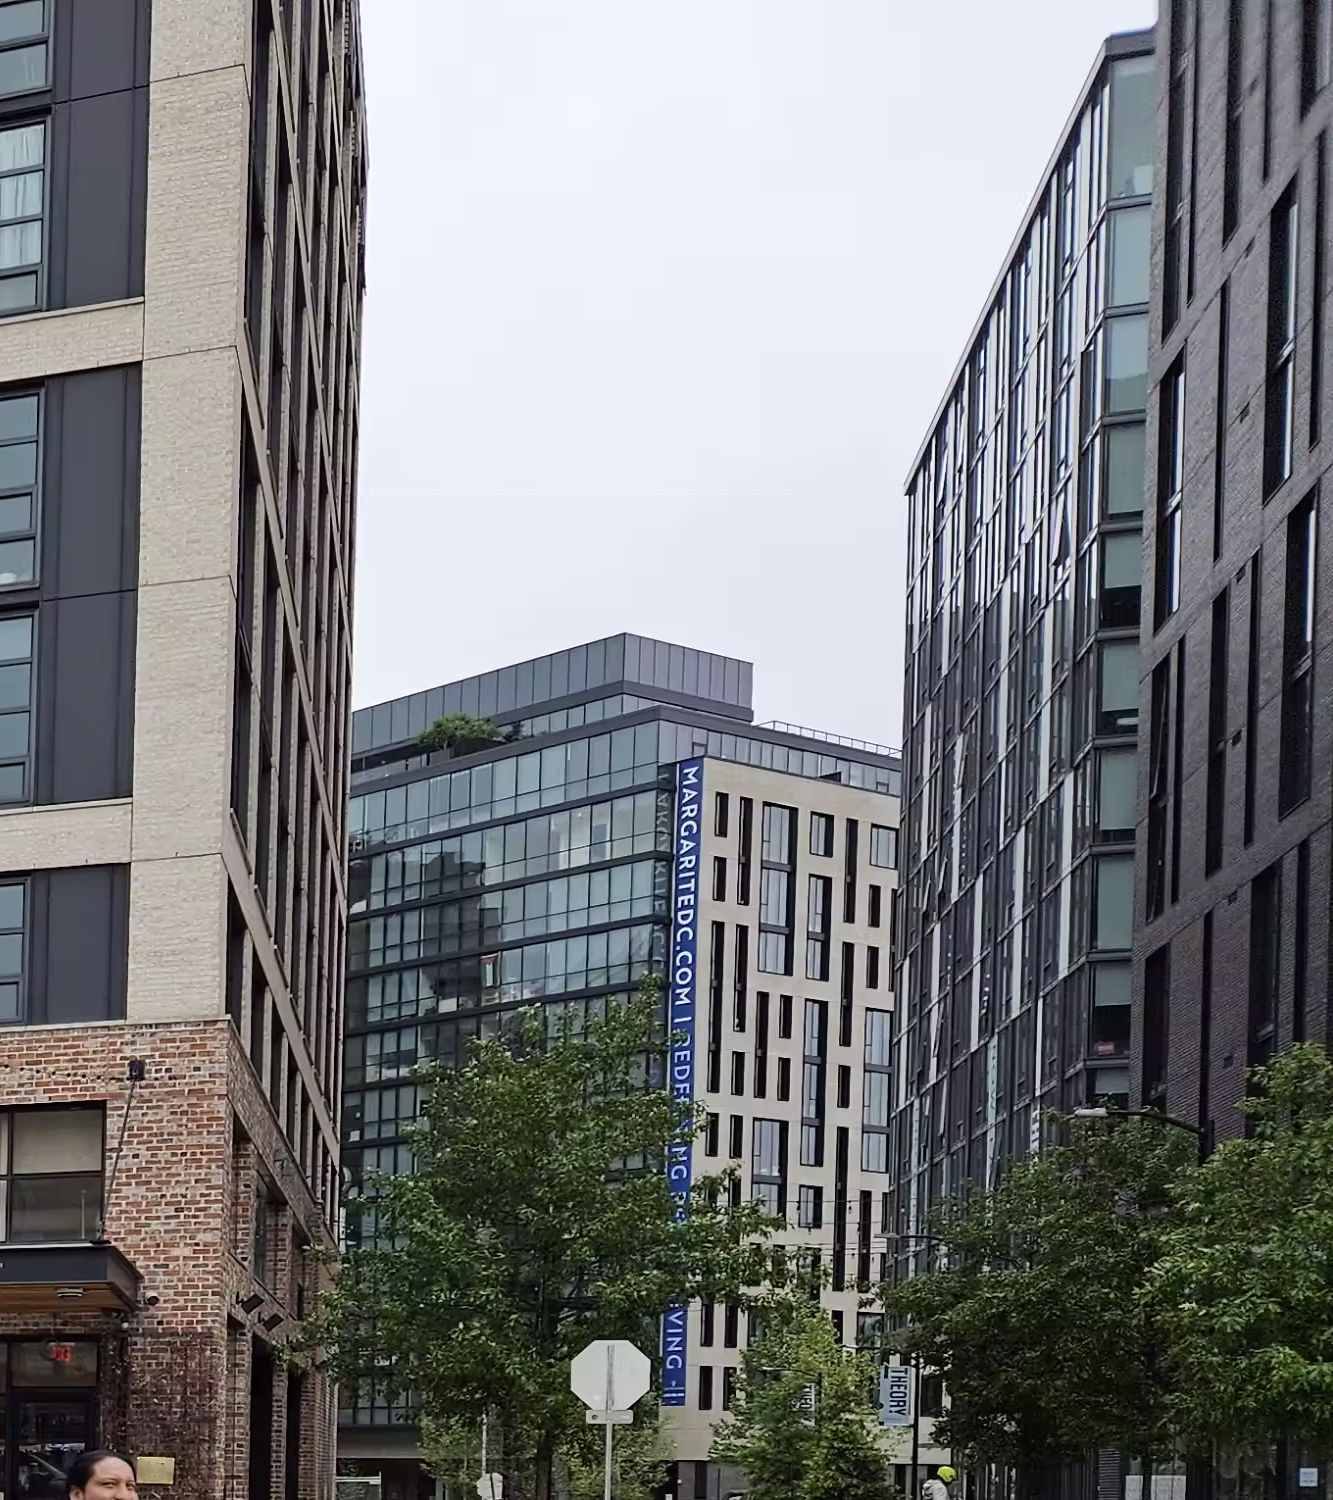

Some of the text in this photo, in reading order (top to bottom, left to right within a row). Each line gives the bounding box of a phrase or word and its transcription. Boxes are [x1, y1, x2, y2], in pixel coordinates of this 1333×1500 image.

[674, 765, 699, 1006] MARGARITEDC.COM
[666, 1310, 684, 1369] VING
[888, 1367, 909, 1416] THEORY
